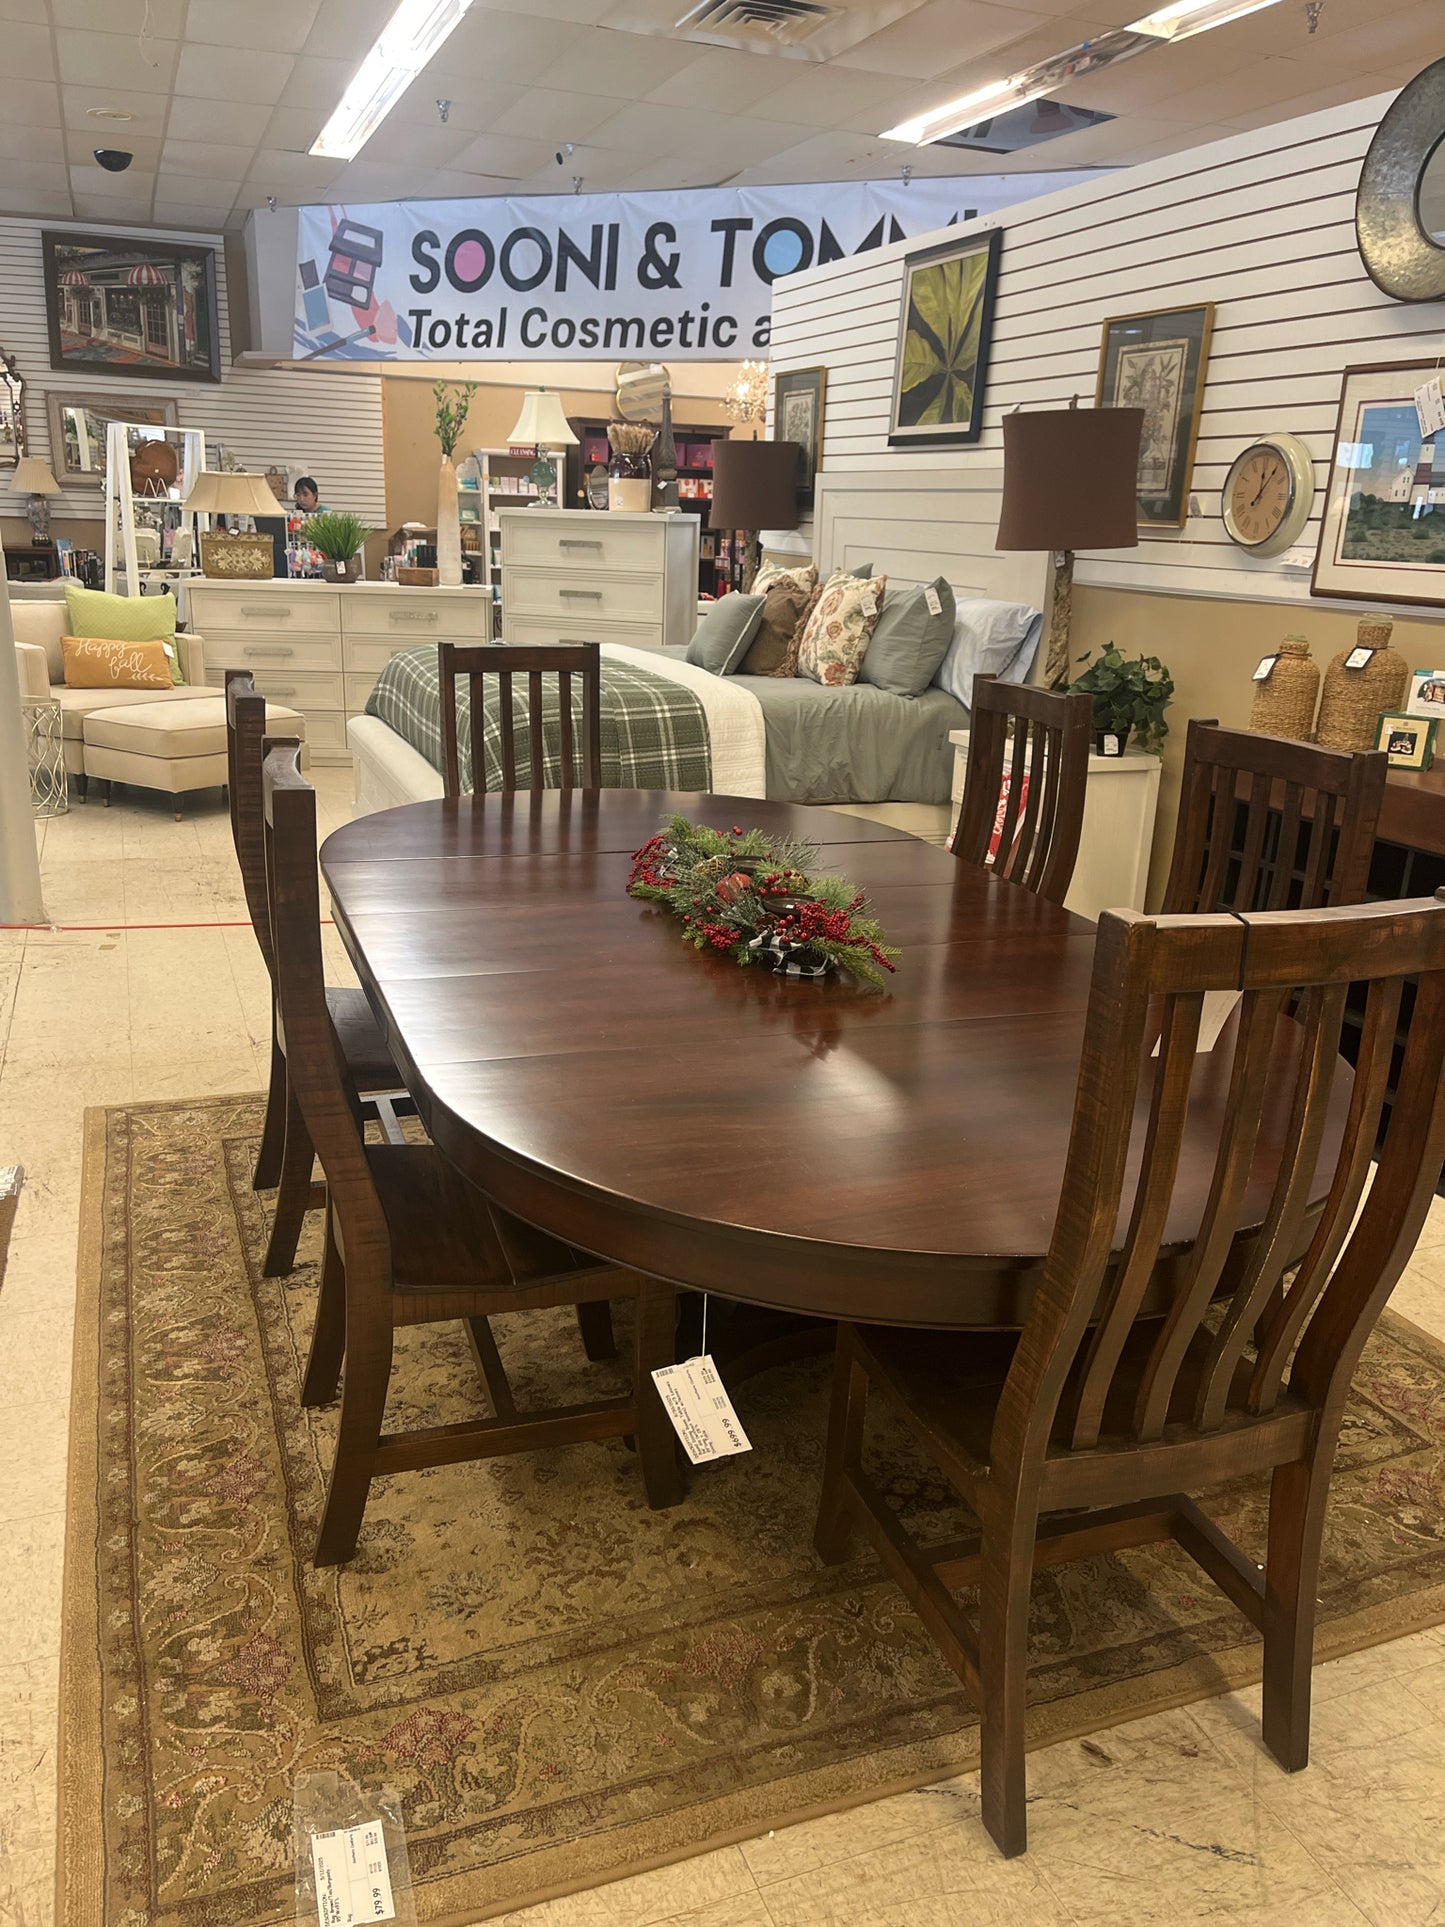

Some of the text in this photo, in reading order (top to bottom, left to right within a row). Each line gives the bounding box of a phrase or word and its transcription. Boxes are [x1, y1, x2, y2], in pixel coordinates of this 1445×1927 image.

[409, 223, 620, 294] SOONI
[637, 221, 683, 290] &
[408, 307, 507, 348] Total
[520, 302, 738, 348] Cosmetic
[75, 638, 141, 658] Happy
[722, 1418, 742, 1447] $699.99
[372, 1888, 384, 1915] $79.99
